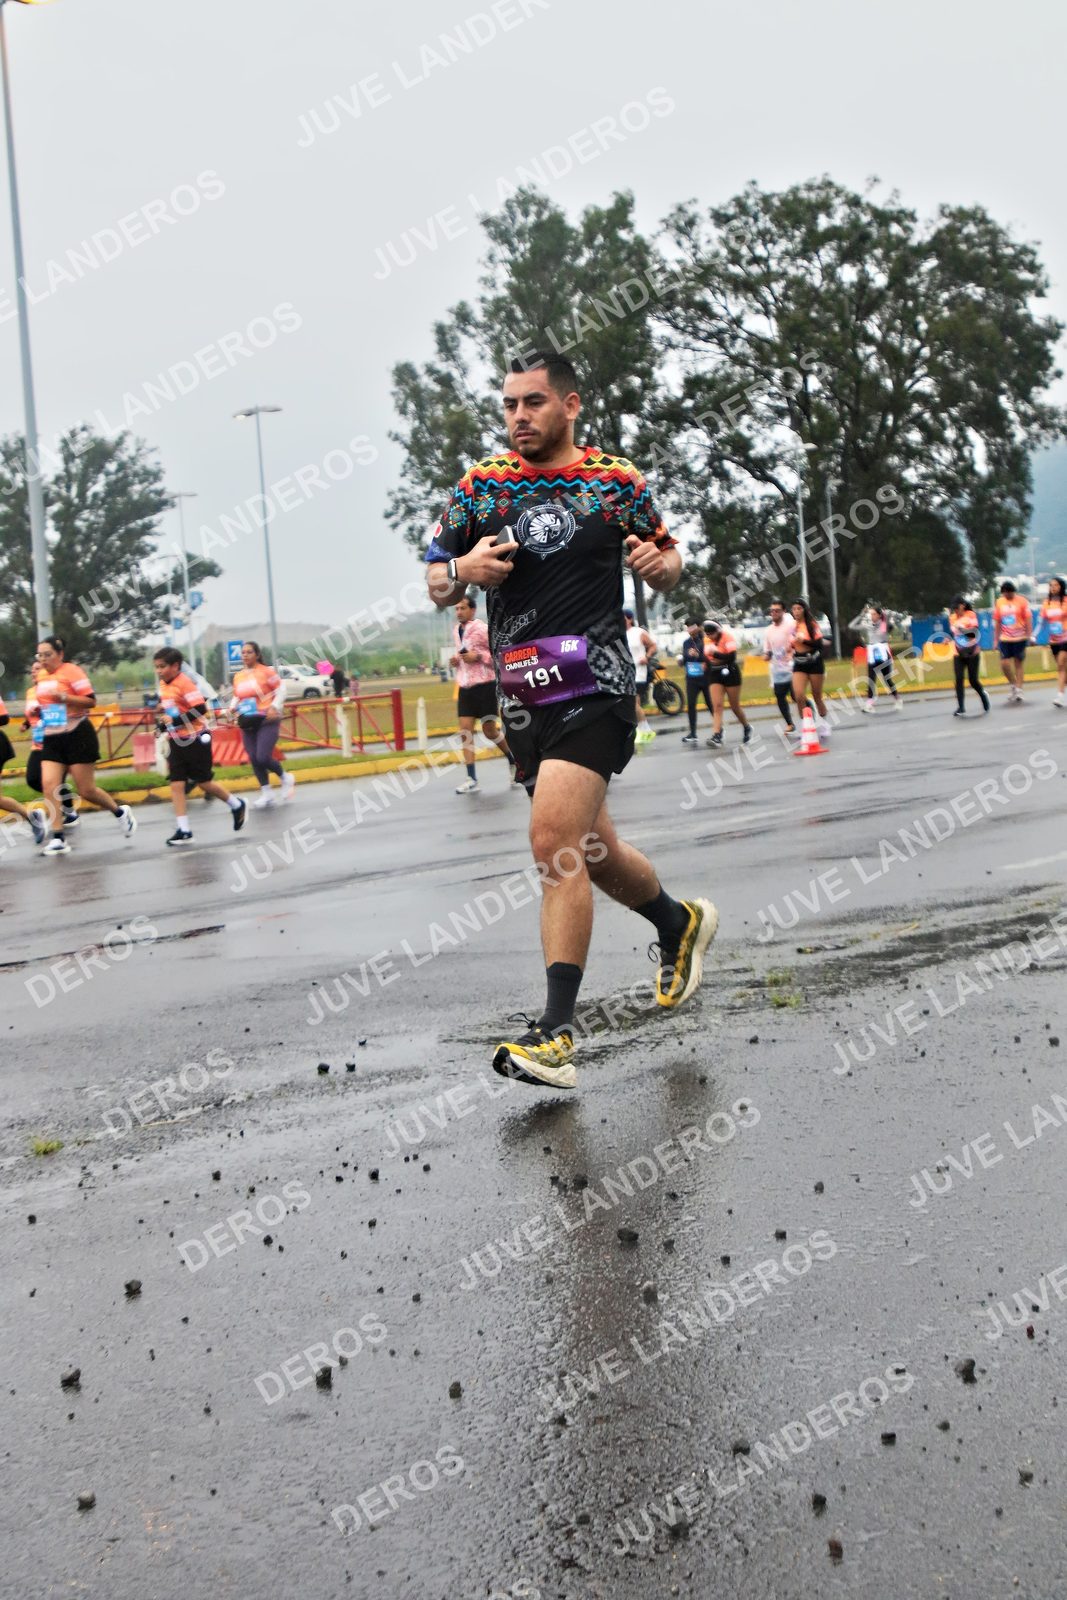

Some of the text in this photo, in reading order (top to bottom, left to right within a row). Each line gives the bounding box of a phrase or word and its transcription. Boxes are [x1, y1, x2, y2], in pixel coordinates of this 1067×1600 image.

[504, 646, 538, 663] CARRERA
[560, 639, 579, 653] 15K
[524, 664, 563, 688] 191
